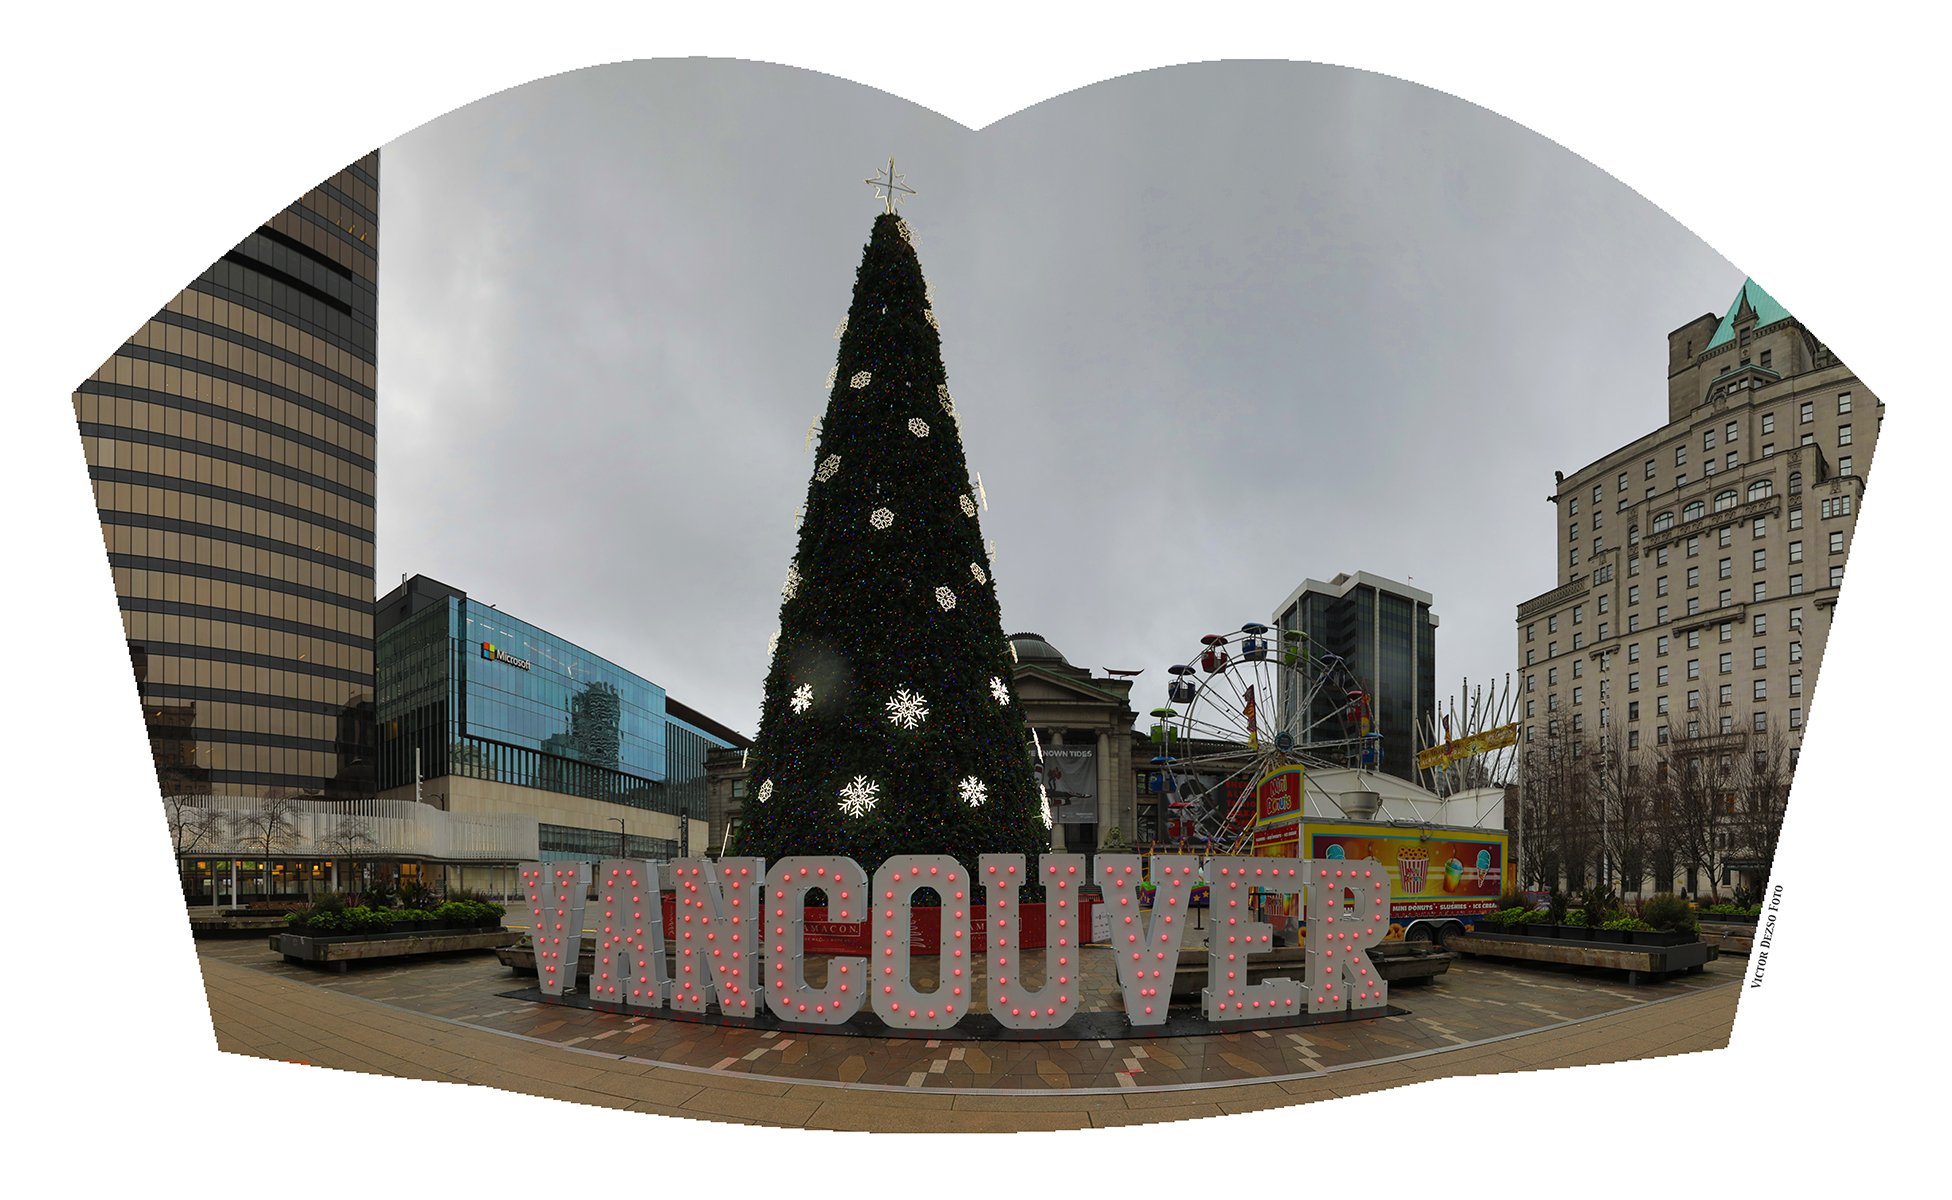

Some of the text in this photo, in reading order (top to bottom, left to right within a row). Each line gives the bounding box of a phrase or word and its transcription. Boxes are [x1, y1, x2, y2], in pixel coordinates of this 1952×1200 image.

[496, 649, 531, 670] Microsoft
[1070, 750, 1093, 758] TIDES
[518, 853, 1391, 1031] VANCOUVER
